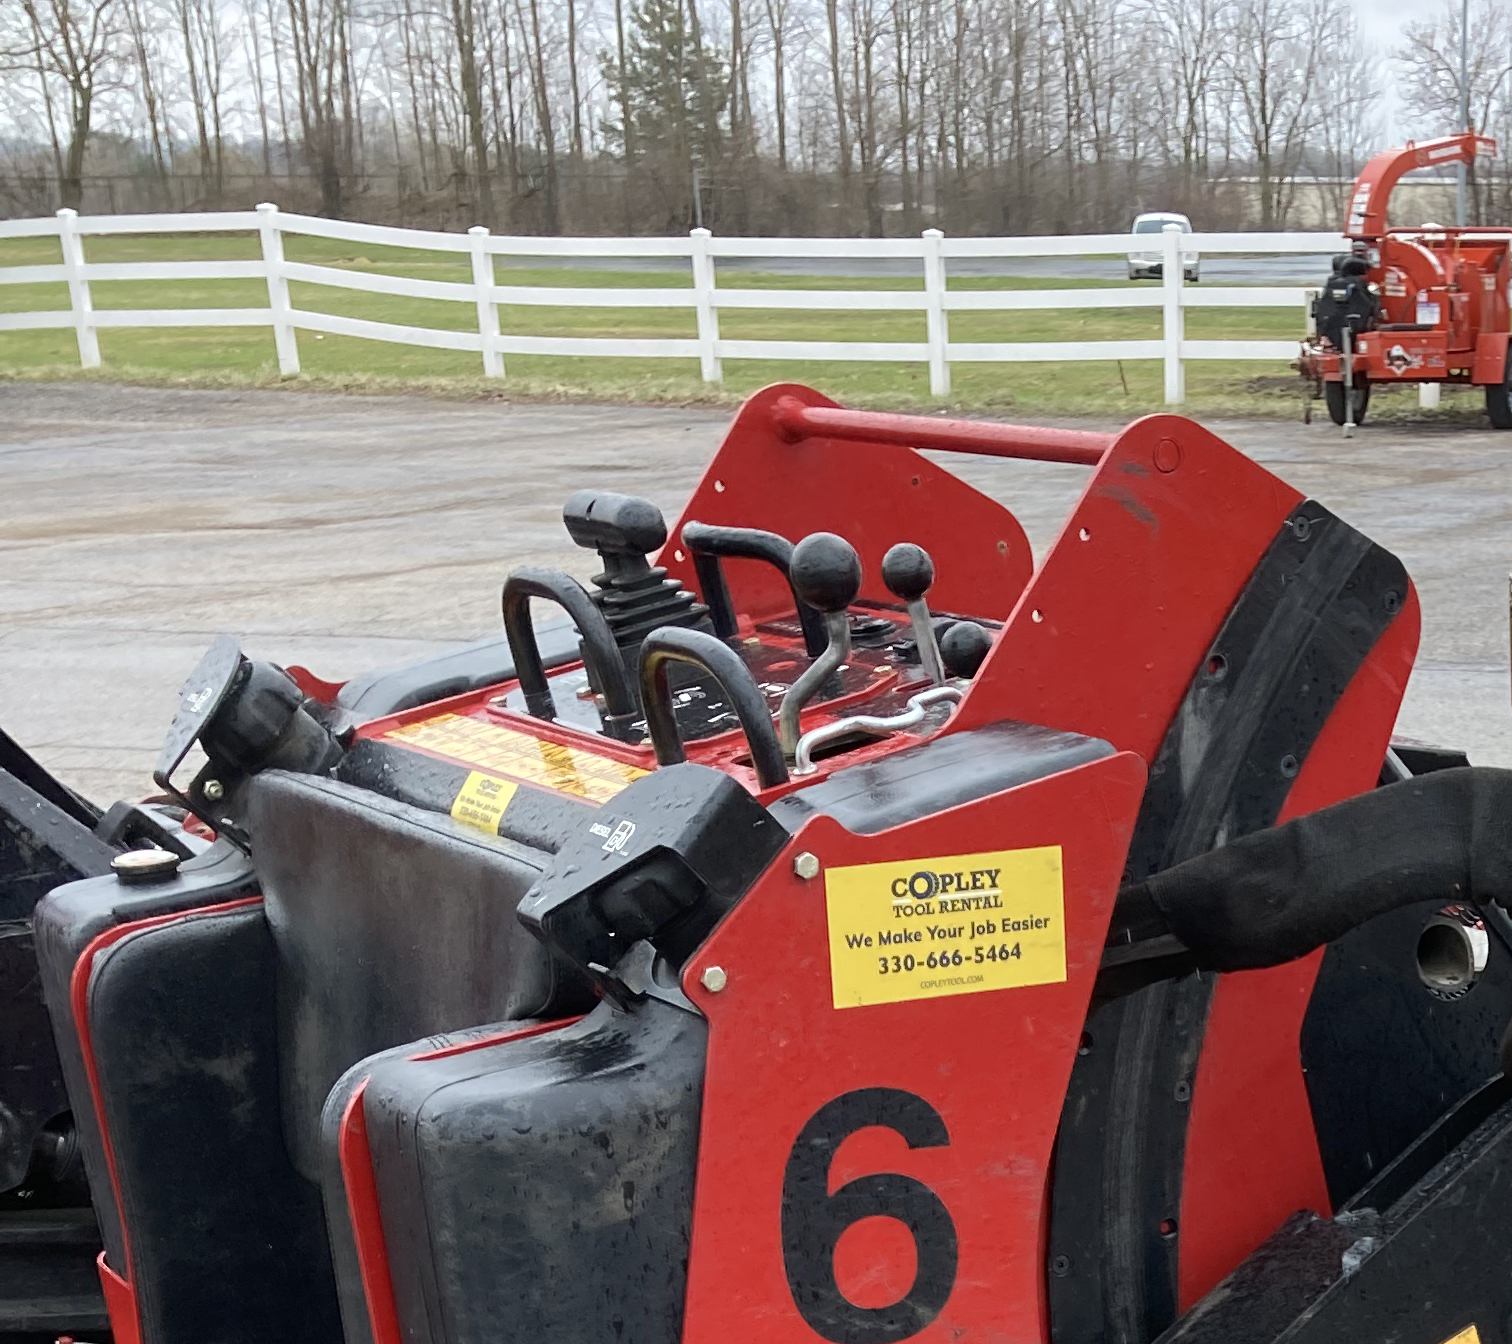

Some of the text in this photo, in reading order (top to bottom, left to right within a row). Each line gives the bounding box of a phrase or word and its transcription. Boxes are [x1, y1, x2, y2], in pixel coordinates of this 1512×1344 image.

[891, 868, 1001, 899] COPLEY
[893, 895, 1003, 918] TOOL RENTAL
[845, 914, 1050, 949] We Make Your Job Easier
[878, 942, 1022, 975] 330-666-5464
